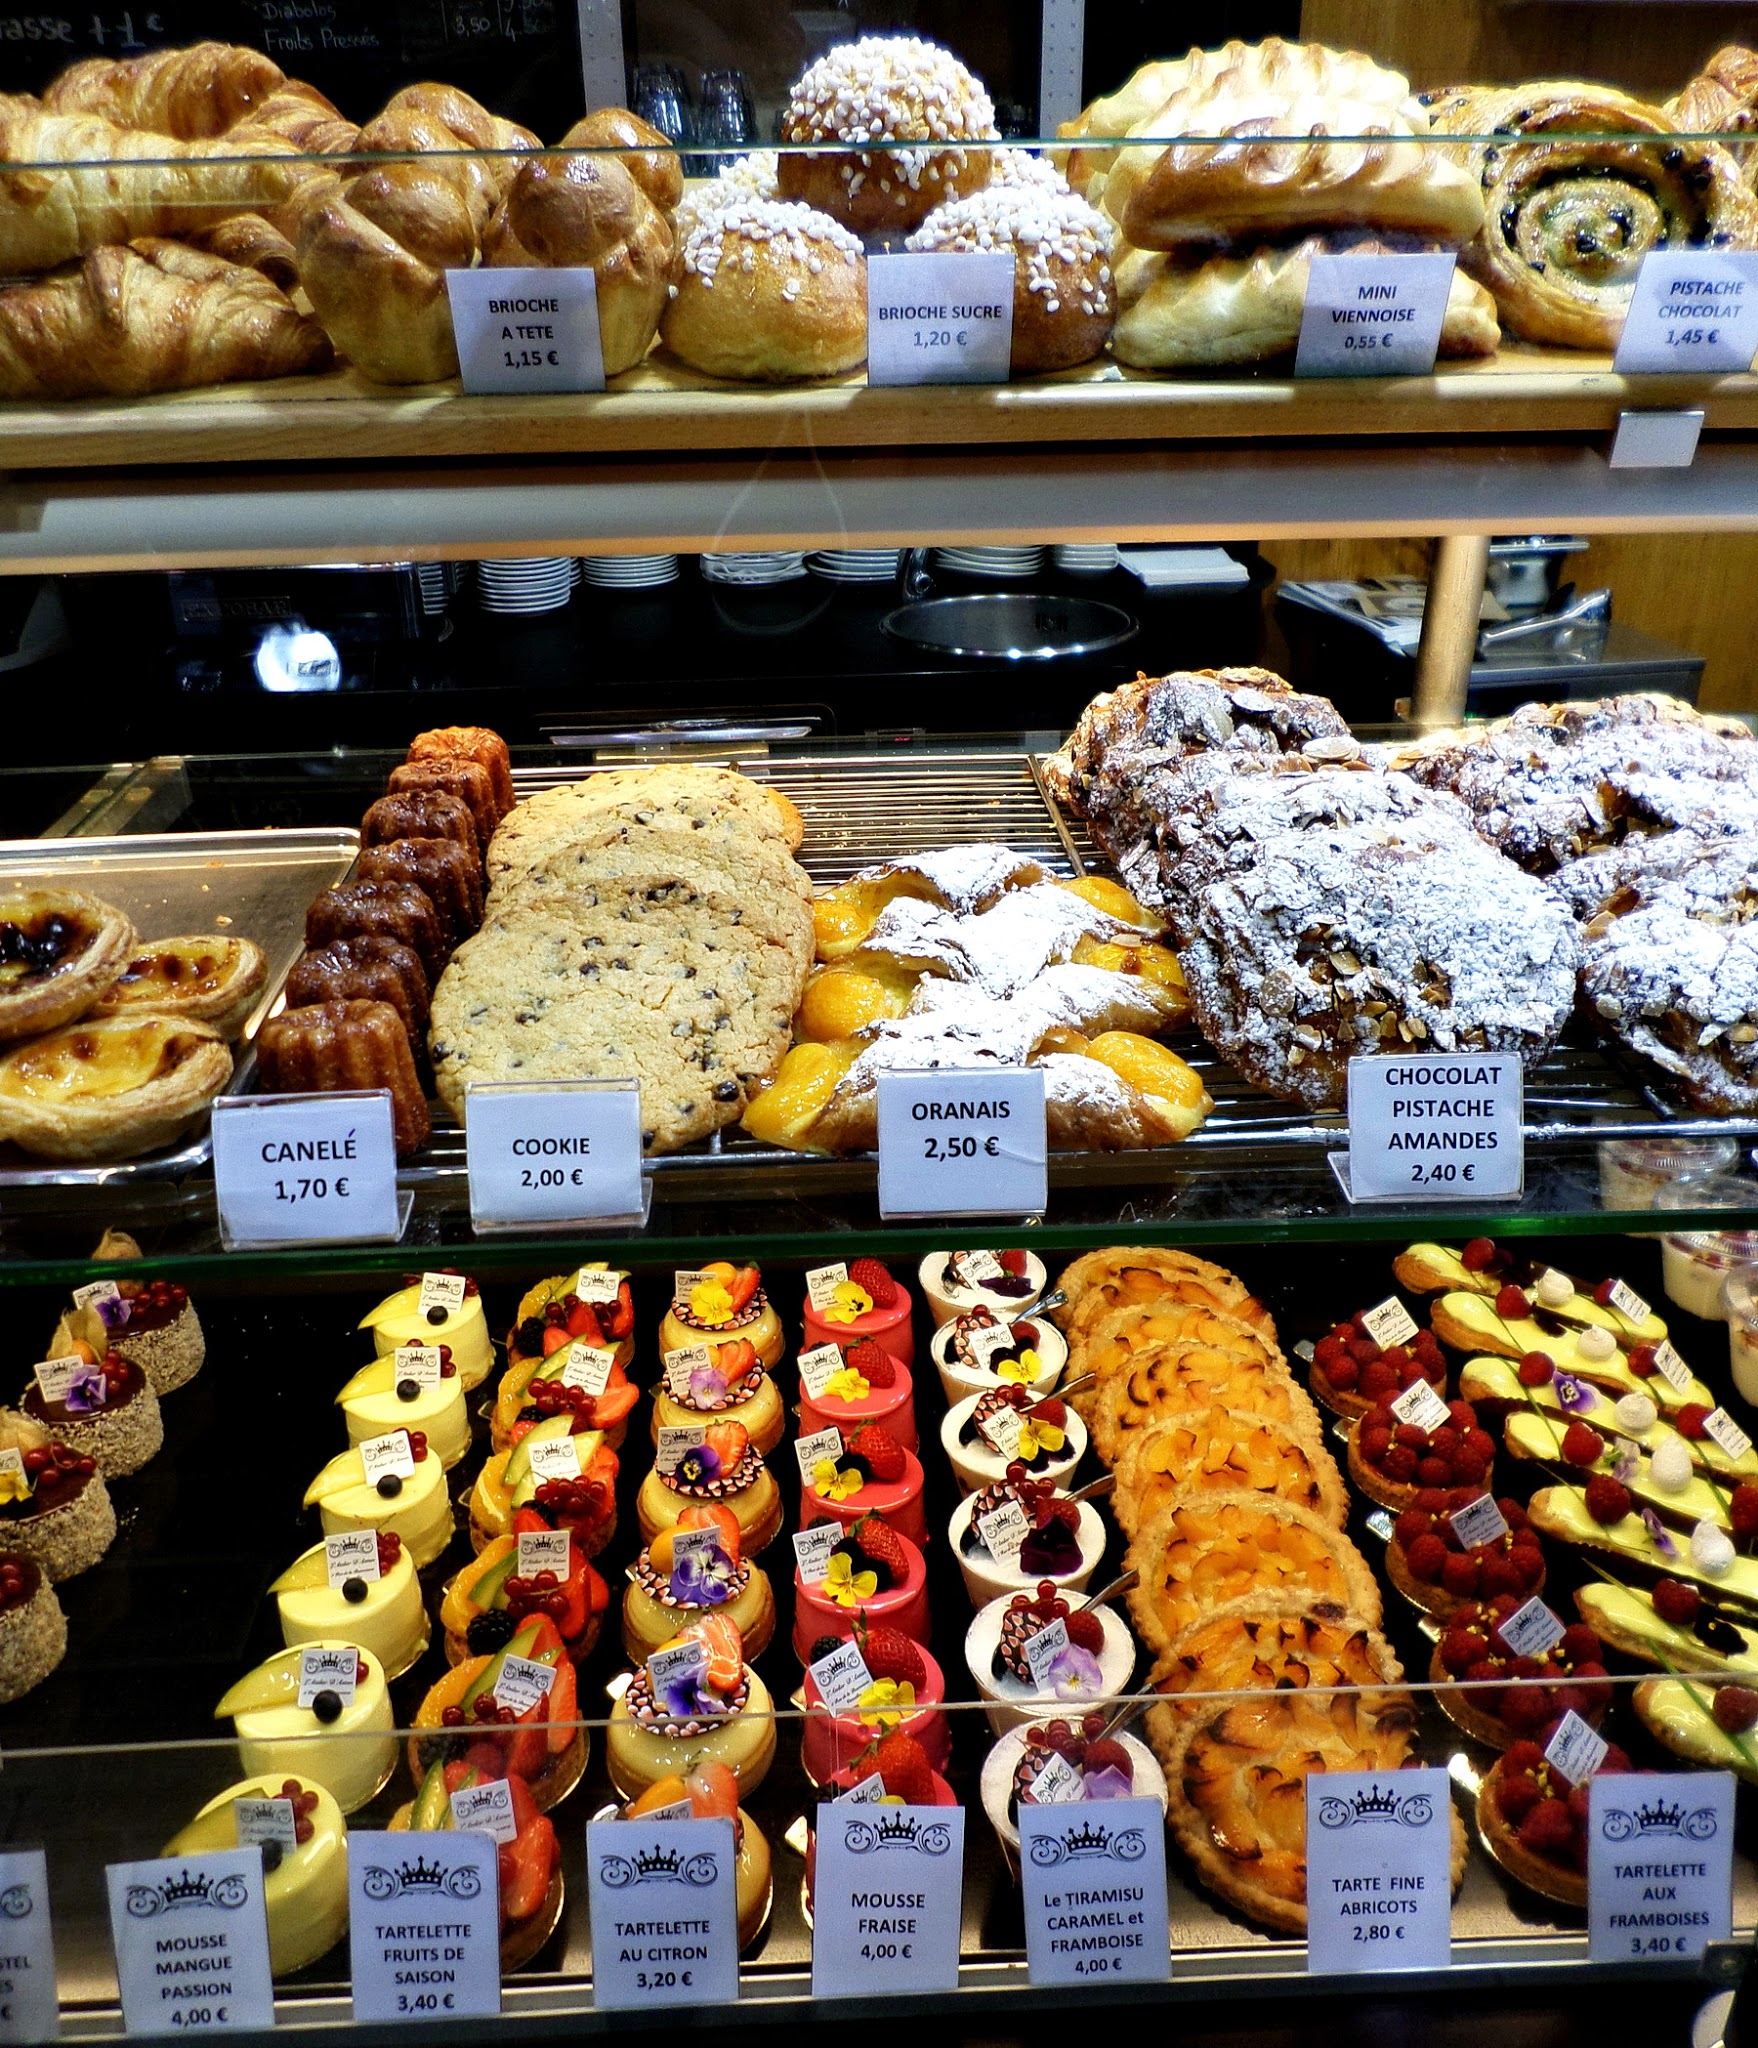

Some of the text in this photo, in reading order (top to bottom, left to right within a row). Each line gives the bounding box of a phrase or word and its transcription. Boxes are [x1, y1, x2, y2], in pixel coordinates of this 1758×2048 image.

[1358, 286, 1397, 299] MINI
[1670, 281, 1745, 295] PISTACHE
[489, 299, 559, 313] BRIOCHE
[879, 306, 1002, 320] BRIOCHE SUCRE
[1658, 305, 1743, 318] CHOCOLAT
[1332, 309, 1415, 323] VIENNOISE
[502, 326, 553, 339] A TETE
[914, 331, 967, 349] 1,20 €
[1665, 329, 1720, 346] 1,45 €
[1345, 333, 1393, 350] 0,55 €
[505, 351, 559, 369] 1,15 €
[1386, 1067, 1502, 1085] CHOCOLAT
[912, 1101, 1010, 1120] ORANAIS
[1393, 1099, 1494, 1117] PISTACHE
[262, 1128, 357, 1163] CANELÉ
[513, 1138, 590, 1155] COOKIE
[924, 1136, 1000, 1161] 2,50 €
[1388, 1131, 1498, 1150] AMANDES
[522, 1169, 583, 1189] 2,00 €
[1411, 1164, 1475, 1184] 2,40 €
[275, 1177, 350, 1203] 1,70 €
[1614, 1864, 1706, 1879] TARTELETTE
[1332, 1877, 1425, 1892] TARTE FINE
[851, 1893, 925, 1908] MOUSSE
[1044, 1887, 1144, 1908] Le TIRAMISU
[1643, 1887, 1676, 1900] AUX
[1341, 1900, 1417, 1916] ABRICOTS
[615, 1921, 710, 1936] TARTELETTE
[859, 1919, 916, 1933] FRAISE
[1048, 1912, 1144, 1930] CARAMEL et
[1610, 1912, 1710, 1928] FRAMBOISES
[375, 1924, 471, 1939] TARTELETTE
[1353, 1925, 1405, 1943] 2,80 €
[156, 1934, 227, 1953] MOUSSE
[1051, 1934, 1143, 1953] FRAMBOISE
[1631, 1938, 1687, 1955] 3,40 €
[384, 1948, 465, 1962] FRUITS DE
[620, 1947, 707, 1962] AU CITRON
[861, 1945, 912, 1961] 4,00 €
[156, 1956, 232, 1975] MANGUE
[1075, 1958, 1122, 1975] 4,00 €
[395, 1970, 455, 1984] SAISON
[637, 1971, 693, 1990] 3,20 €
[162, 1982, 232, 1999] PASSION
[398, 1994, 454, 2013] 3,40 €
[172, 2007, 228, 2026] 4,00 €
